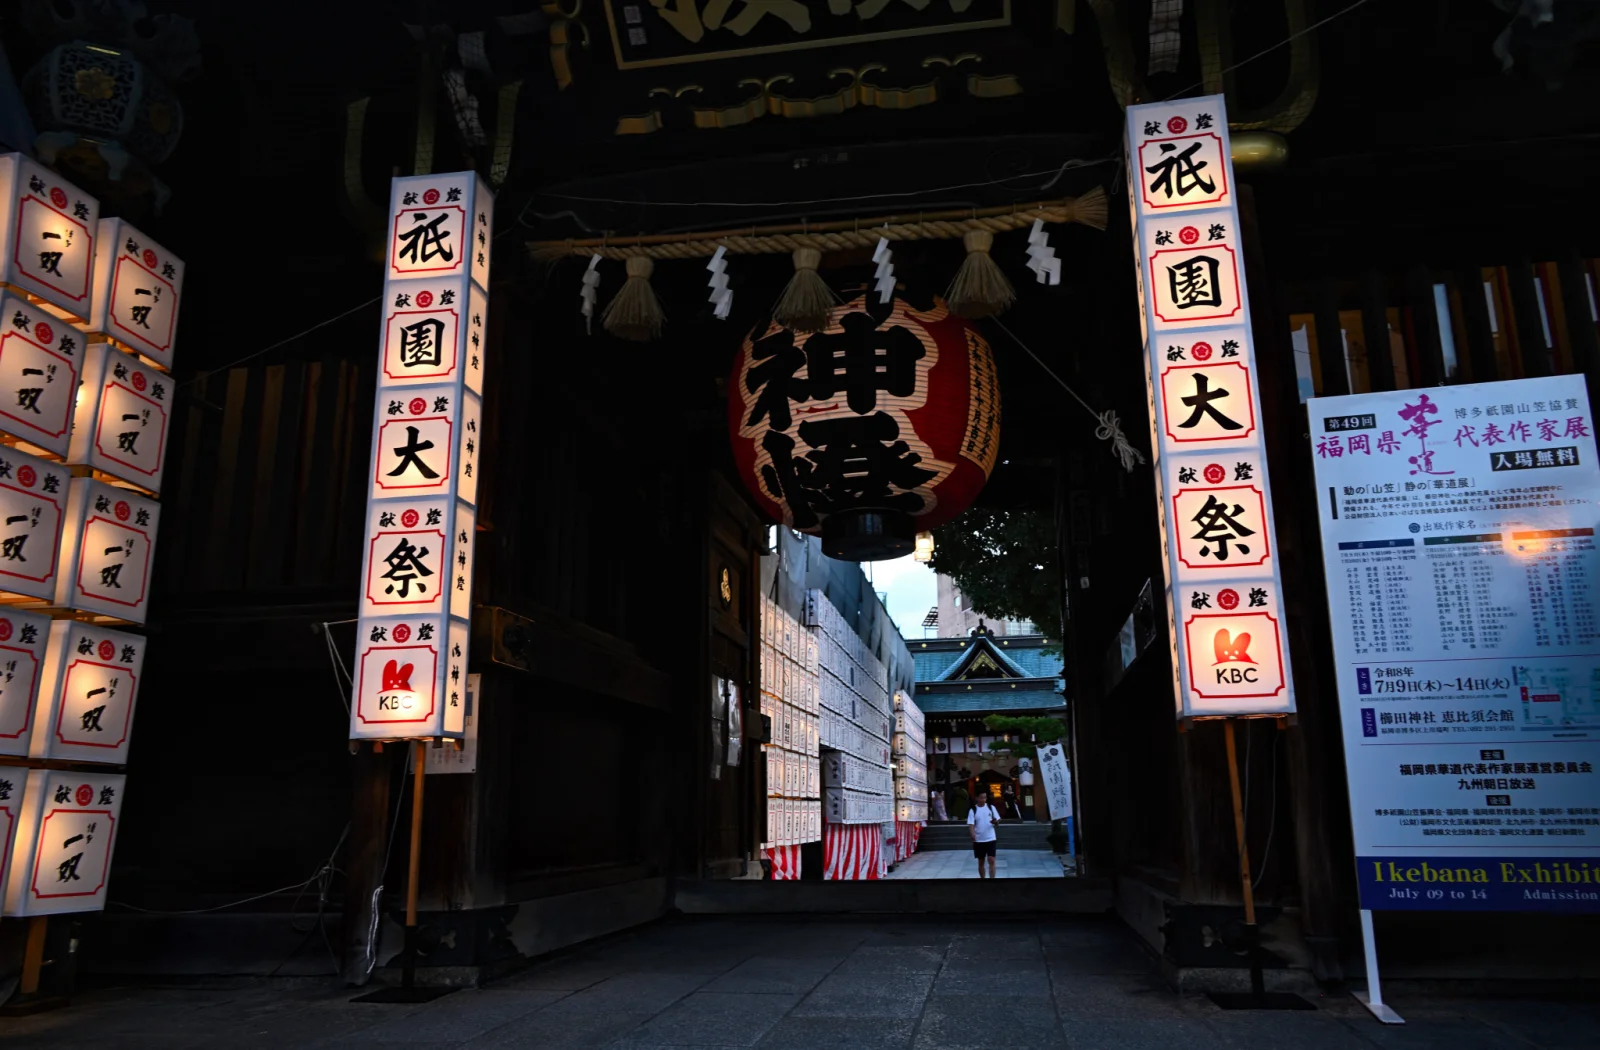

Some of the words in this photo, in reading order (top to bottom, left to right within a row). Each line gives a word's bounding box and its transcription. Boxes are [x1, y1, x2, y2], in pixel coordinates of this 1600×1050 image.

[38, 230, 64, 277] 一双
[1166, 255, 1222, 310] 園
[129, 287, 152, 329] 一双
[400, 317, 445, 368] 園
[15, 367, 44, 414] 一双
[1177, 373, 1244, 430] 大
[116, 412, 140, 455] 一双
[1328, 415, 1374, 429] 第49回
[1453, 416, 1590, 448] 代表作家展
[386, 426, 440, 479] 大
[1316, 431, 1402, 459] 福岡県
[1495, 449, 1577, 469] 入場無料
[1, 514, 29, 562] 一双
[1190, 495, 1257, 561] 祭
[99, 546, 124, 588] 一双
[380, 537, 434, 598] 祭
[1216, 668, 1259, 684] KBC
[1374, 667, 1414, 677] 令和8年
[80, 687, 106, 732] 一双
[379, 695, 413, 710] KBC
[1380, 711, 1436, 725] 櫛田神社
[1442, 709, 1514, 723] 恵比須会館
[1458, 778, 1536, 791] 九州朝日放送
[56, 834, 84, 883] 一双
[1373, 861, 1489, 883] Ikebana
[1389, 888, 1420, 900] July
[1427, 889, 1443, 899] 09
[1451, 889, 1465, 899] to
[1472, 889, 1487, 899] 14
[1523, 889, 1598, 900] Admission
